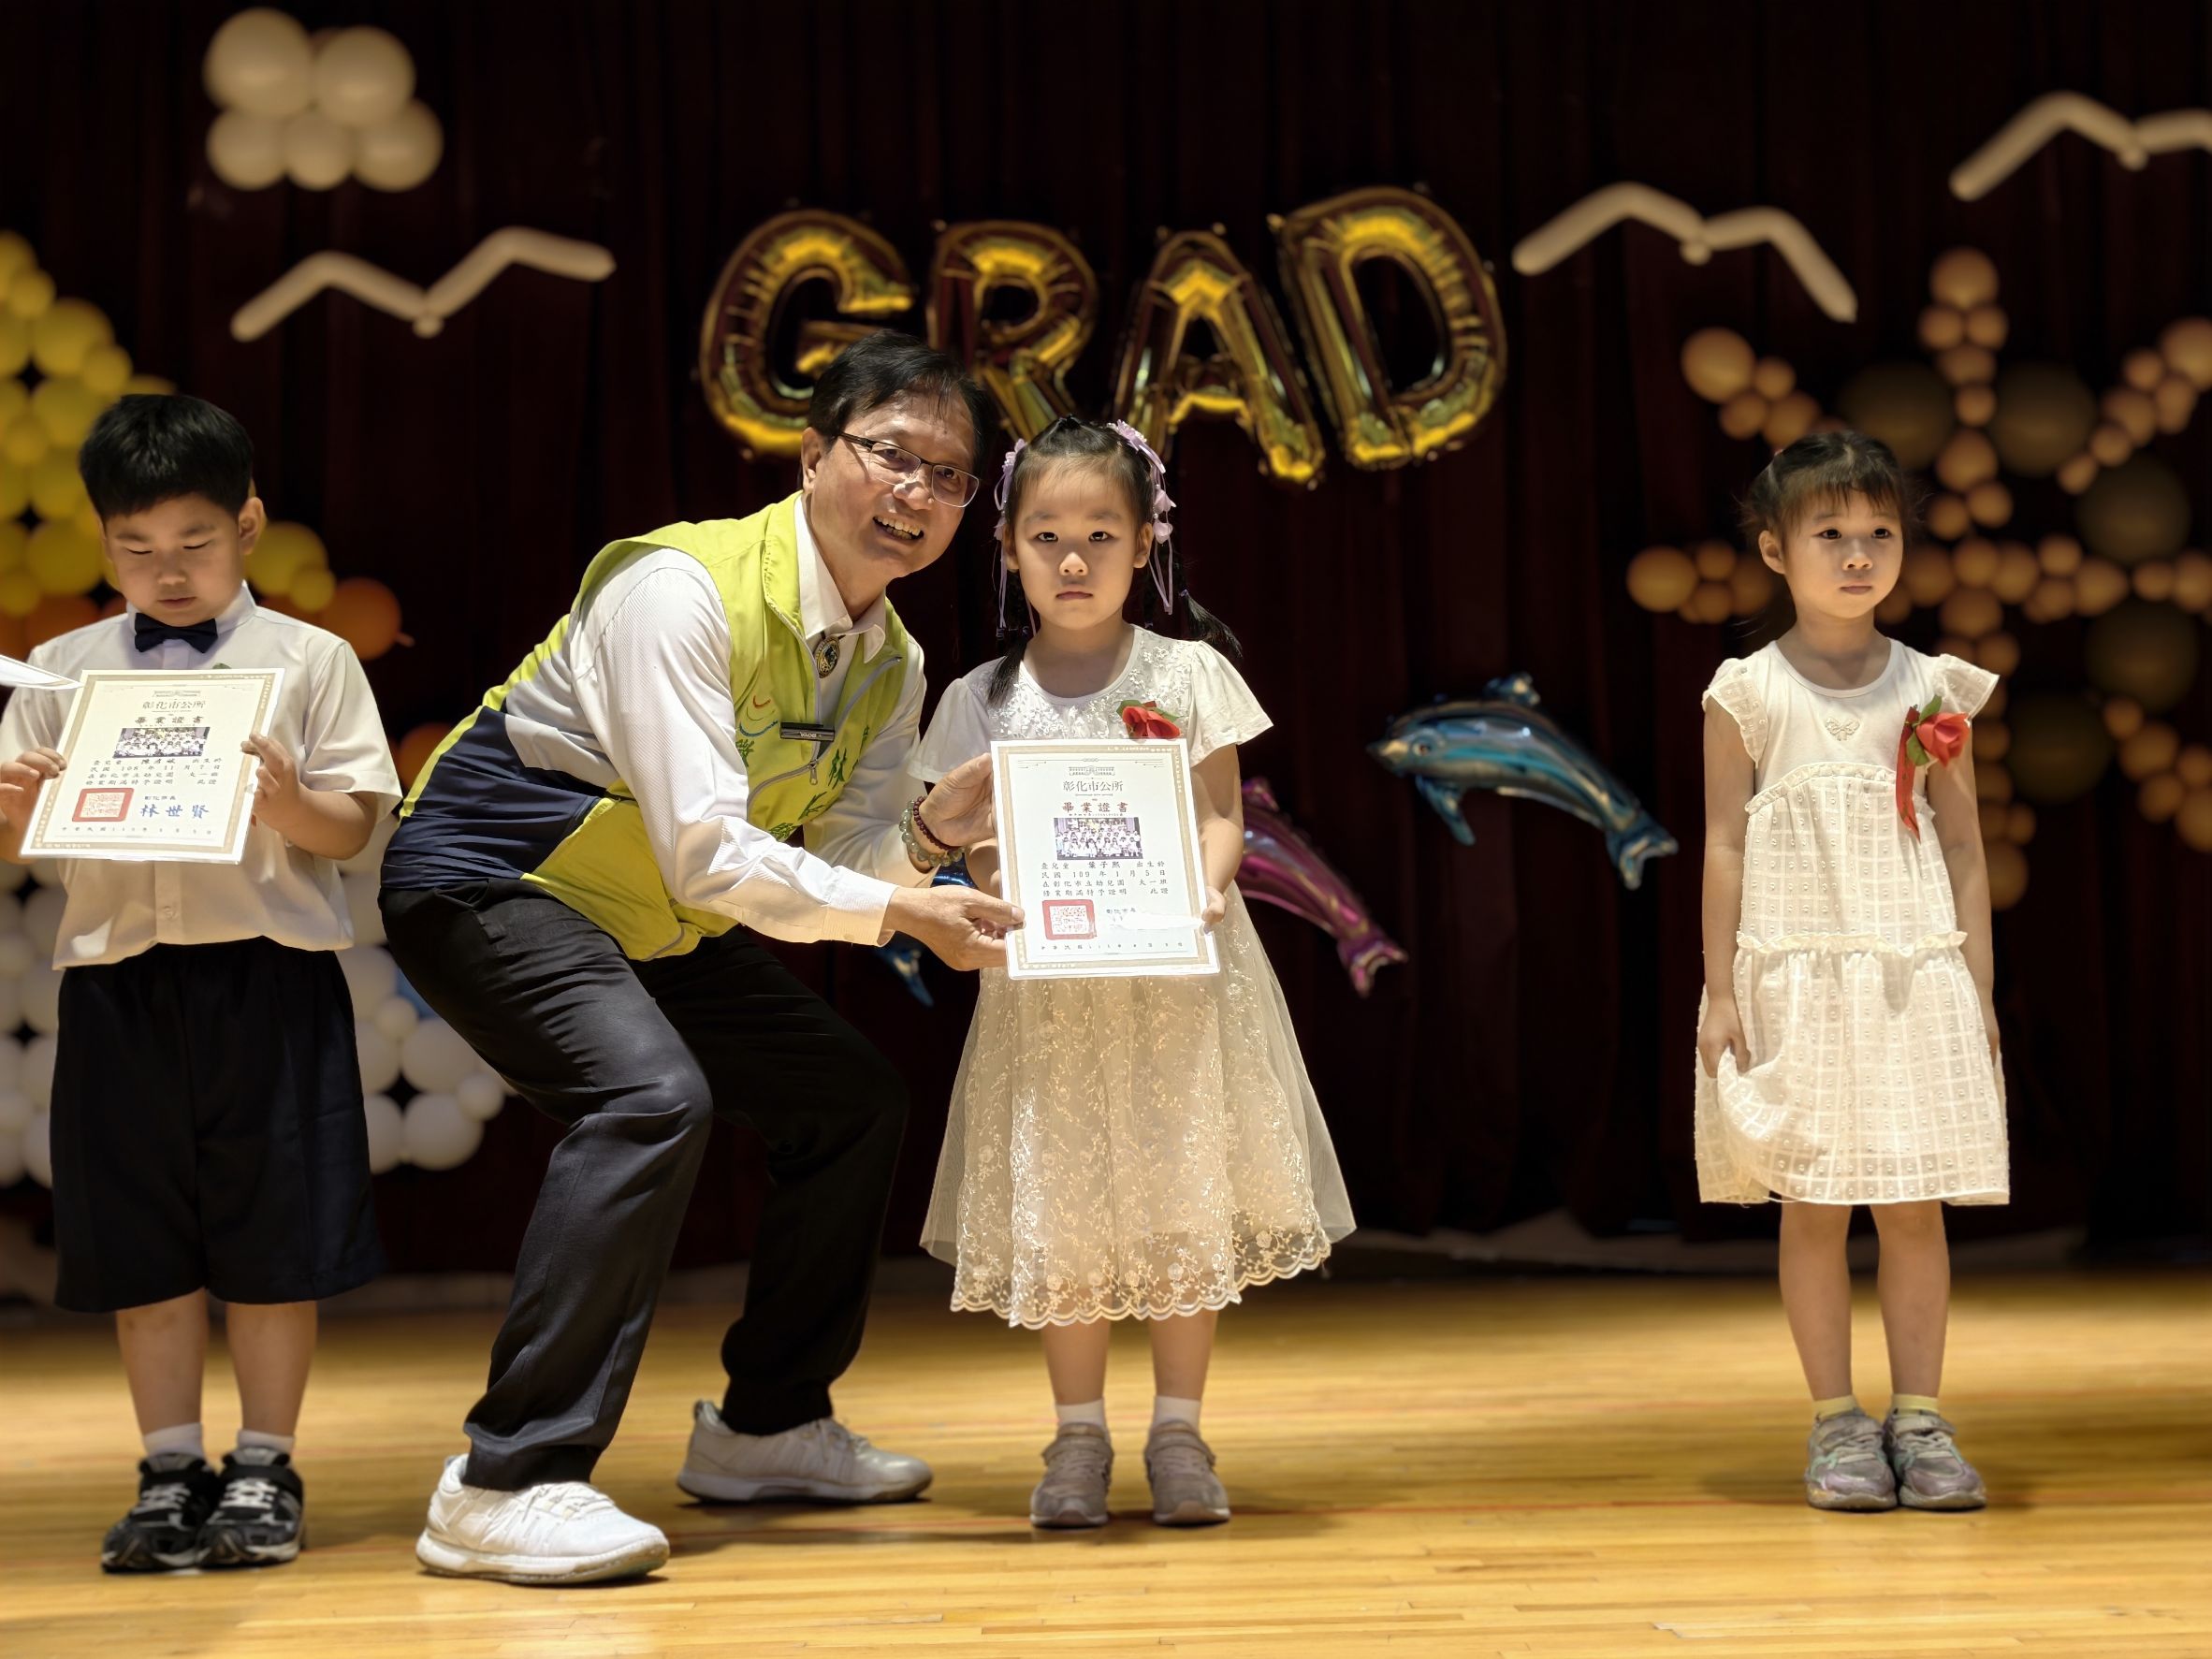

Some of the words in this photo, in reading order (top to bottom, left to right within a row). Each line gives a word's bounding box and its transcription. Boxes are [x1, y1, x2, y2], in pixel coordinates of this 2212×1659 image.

[701, 185, 1508, 487] GRAD
[1063, 780, 1124, 793] 彰化市公所
[1062, 801, 1128, 813] 畢業證書
